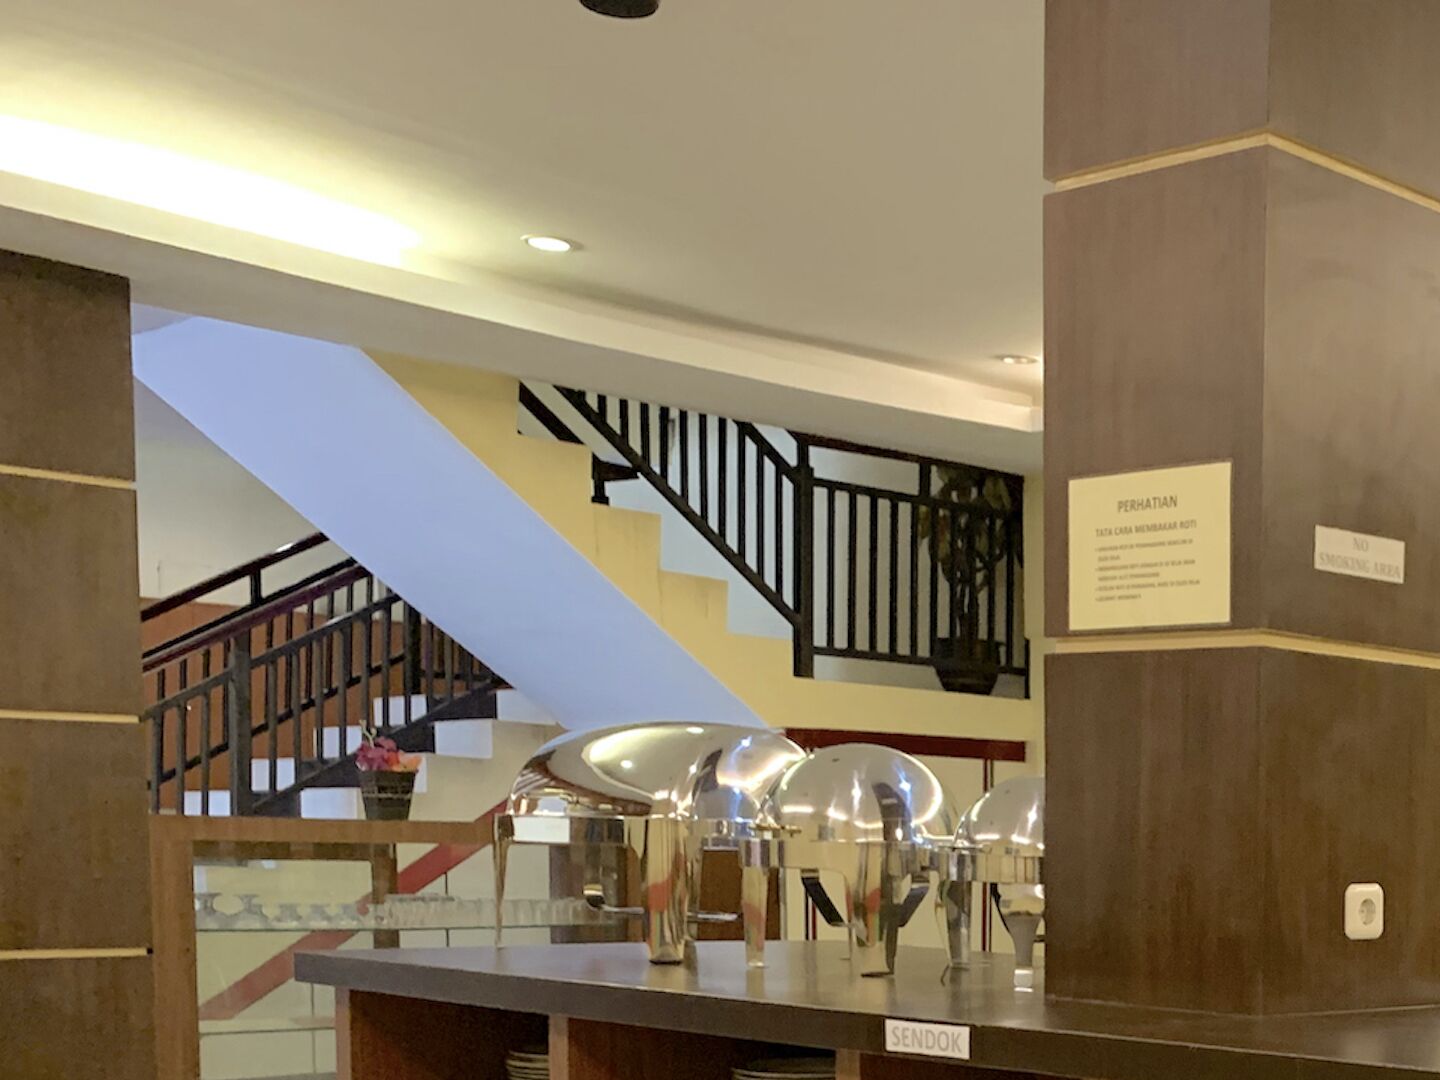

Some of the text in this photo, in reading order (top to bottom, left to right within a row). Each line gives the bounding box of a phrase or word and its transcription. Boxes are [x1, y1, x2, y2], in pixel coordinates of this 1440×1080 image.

[1117, 495, 1178, 513] PERHATIAN
[1095, 527, 1112, 538] TATA
[1114, 525, 1133, 536] CARA
[1180, 519, 1197, 530] ROTI
[1352, 537, 1369, 552] NO
[1319, 552, 1401, 579] SMOKING AREA
[892, 1026, 962, 1053] SENDOK
